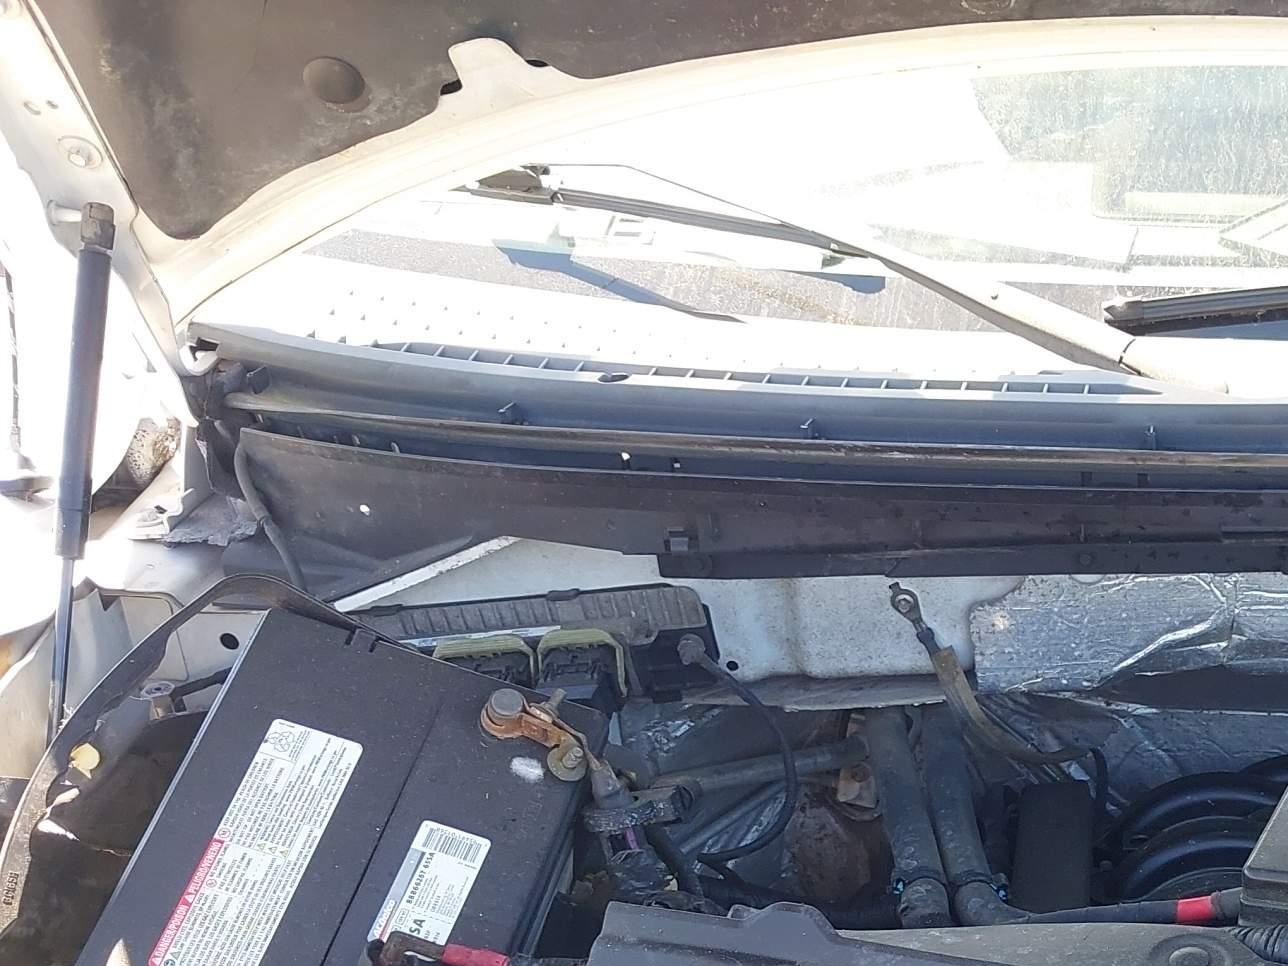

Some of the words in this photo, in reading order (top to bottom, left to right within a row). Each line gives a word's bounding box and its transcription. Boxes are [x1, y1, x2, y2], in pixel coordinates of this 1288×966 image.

[189, 840, 222, 897] PELIGRO/VENENO
[155, 904, 189, 959] DANGER/POISON
[372, 900, 396, 938] ACDelco
[409, 918, 426, 935] SA
